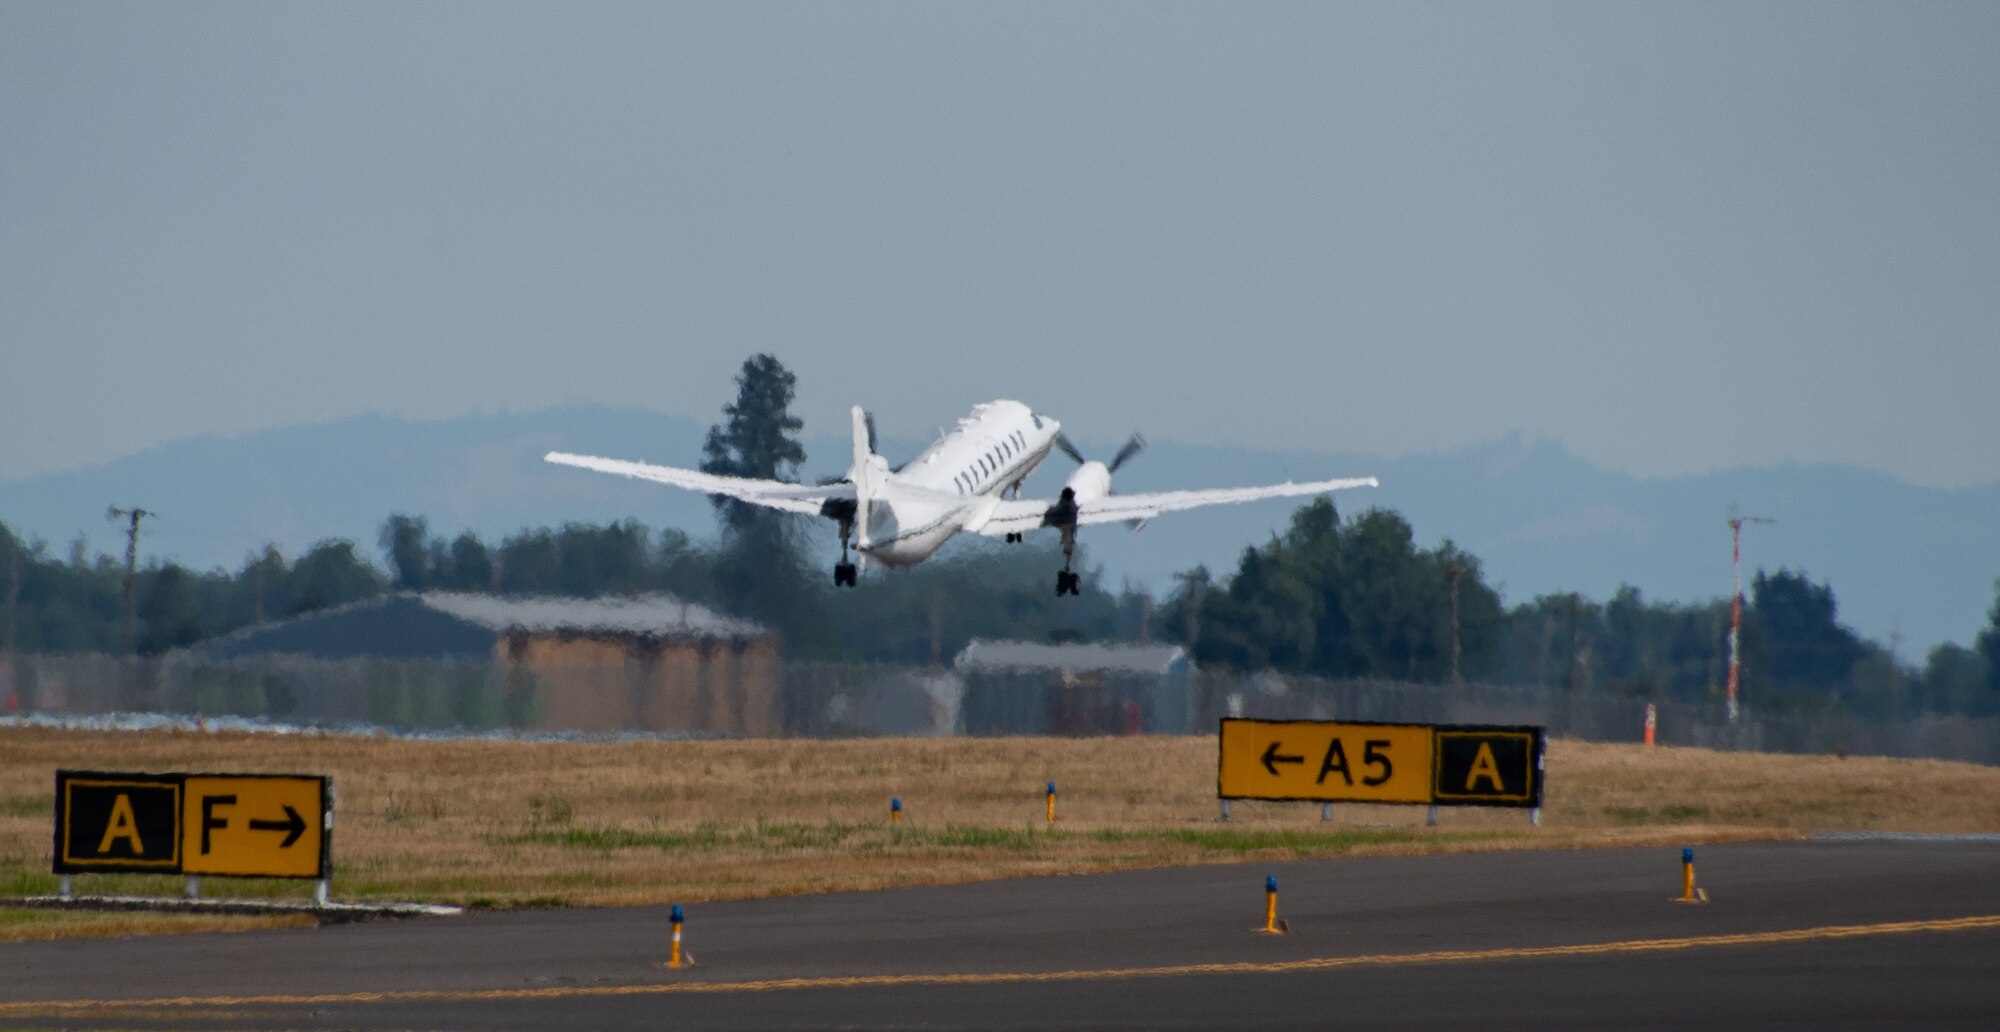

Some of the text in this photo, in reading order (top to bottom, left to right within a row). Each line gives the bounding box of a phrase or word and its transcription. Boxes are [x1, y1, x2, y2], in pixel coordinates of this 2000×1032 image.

[1316, 737, 1505, 791] A5 A
[97, 793, 237, 855] A F
